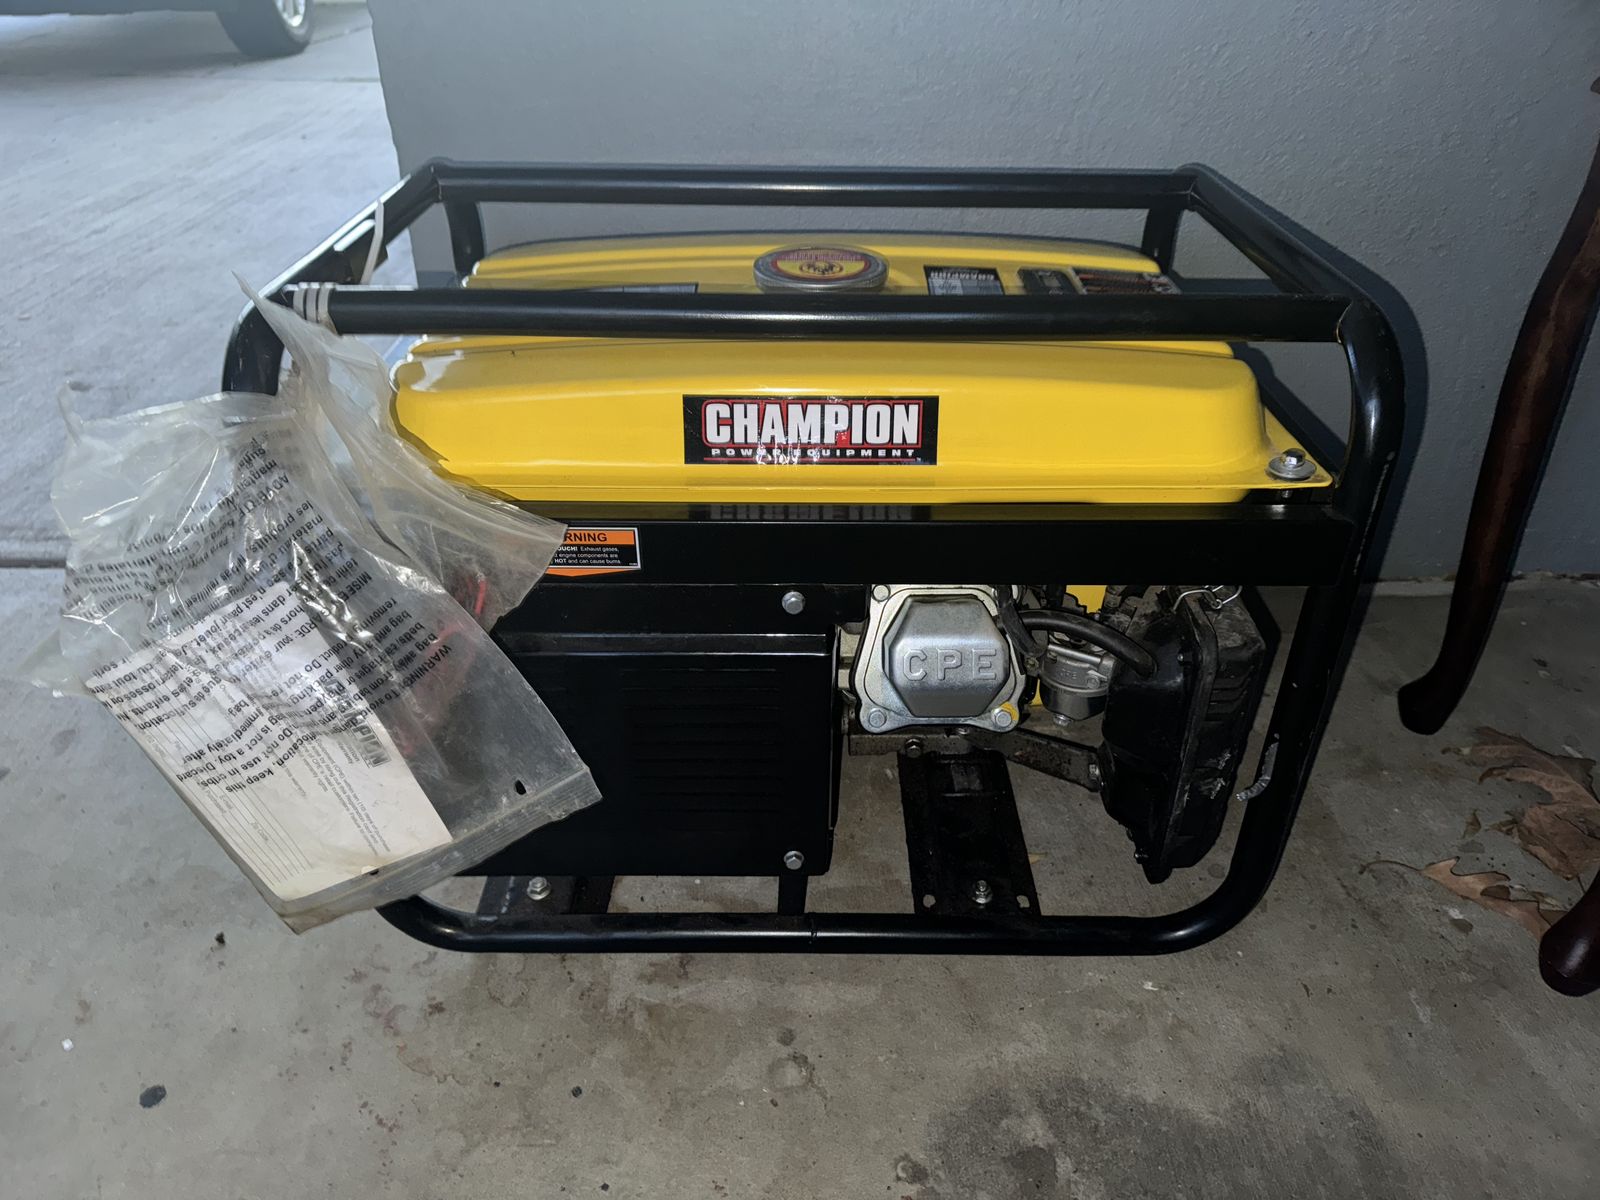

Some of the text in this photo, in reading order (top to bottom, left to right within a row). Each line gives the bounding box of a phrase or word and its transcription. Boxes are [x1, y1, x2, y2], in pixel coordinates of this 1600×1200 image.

[704, 402, 919, 445] CHAMPION
[793, 449, 914, 457] EQUIPMENT
[295, 500, 312, 516] les
[245, 512, 294, 553] produits.
[564, 532, 608, 542] RNING
[335, 558, 358, 579] tenir
[345, 570, 371, 595] MISE
[241, 586, 265, 610] n'est
[261, 594, 285, 616] dans
[279, 604, 304, 625] hors
[387, 610, 411, 629] bag
[191, 620, 221, 646] jouet.
[373, 626, 390, 643] and
[414, 632, 437, 651] bag
[303, 658, 320, 674] Do
[333, 656, 353, 673] other
[903, 649, 997, 681] CPE
[112, 671, 137, 687] tout
[283, 671, 303, 689] not
[289, 670, 332, 705] packing
[345, 675, 354, 685] or
[368, 670, 392, 690] from
[128, 694, 169, 714] enfants.
[383, 689, 398, 702] To
[205, 707, 263, 754] immediately
[277, 726, 292, 741] Do
[245, 733, 263, 750] not
[262, 740, 279, 757] not
[181, 748, 206, 764] after
[214, 753, 236, 764] toy.
[236, 747, 244, 756] a
[176, 761, 215, 781] Discard
[227, 767, 240, 776] in
[240, 756, 261, 771] use
[197, 772, 227, 788] cribs,
[244, 767, 273, 785] keep
[225, 780, 246, 792] this
